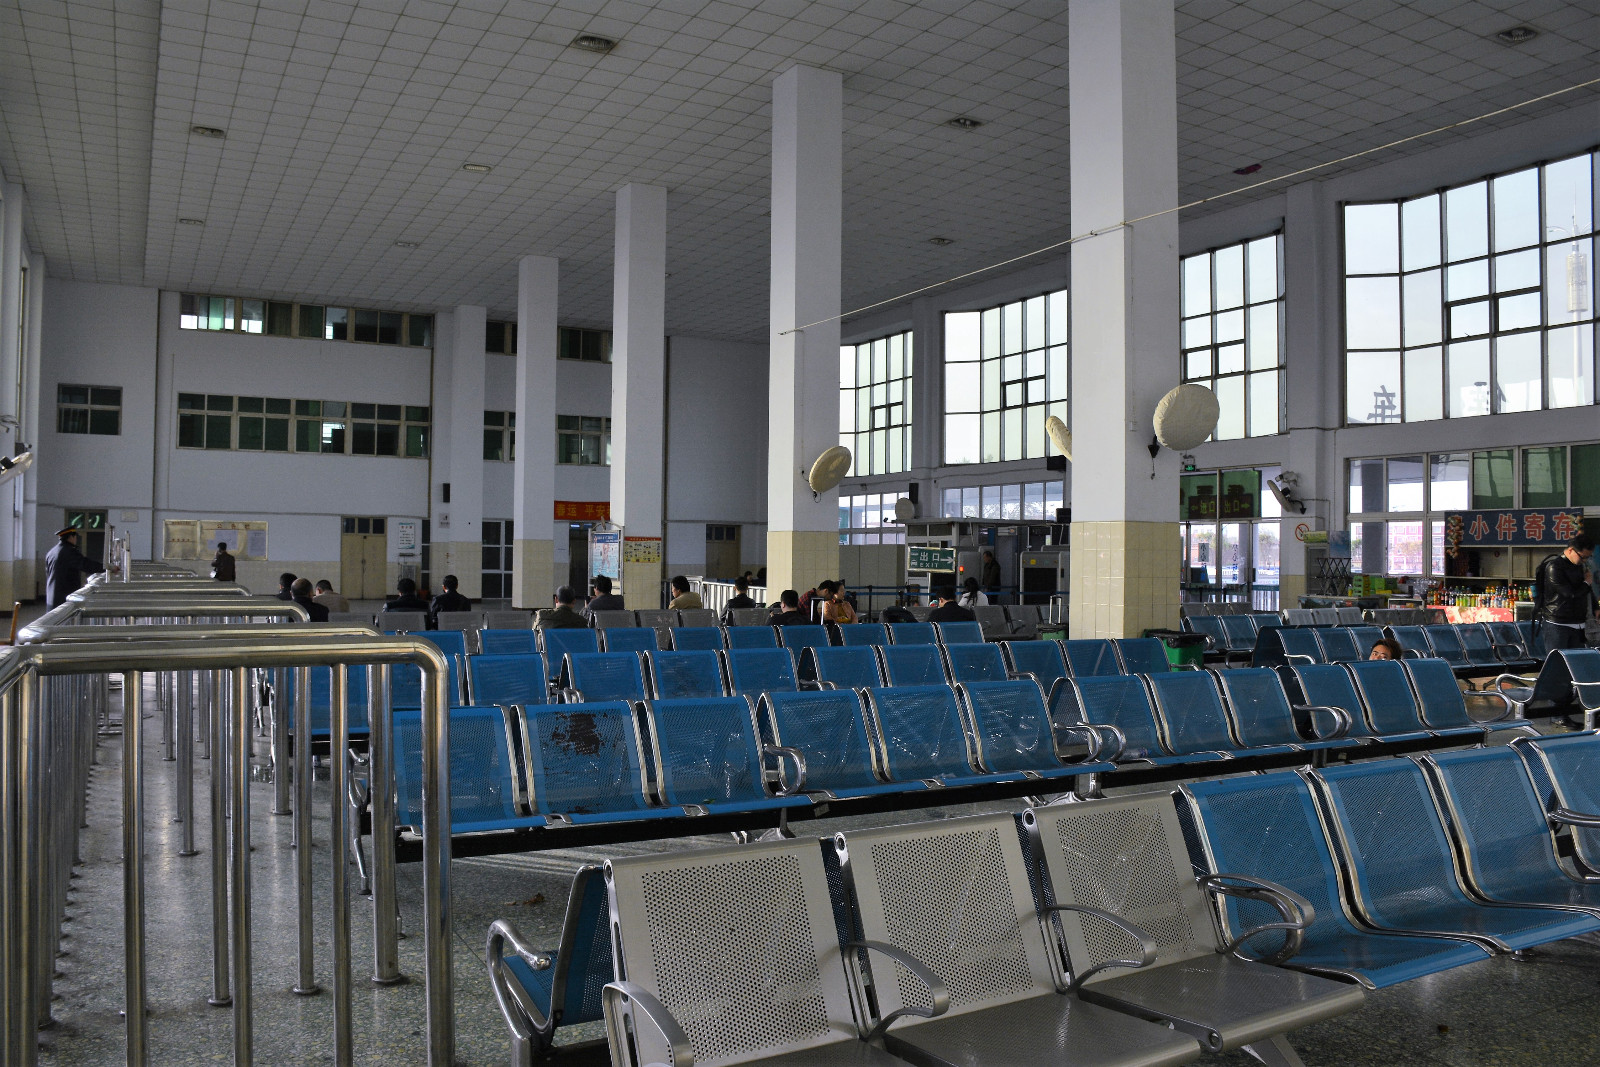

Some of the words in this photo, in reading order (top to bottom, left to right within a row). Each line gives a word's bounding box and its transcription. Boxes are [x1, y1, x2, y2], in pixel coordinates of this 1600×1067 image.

[1448, 512, 1575, 541] 小件寄存
[920, 551, 940, 562] 出口
